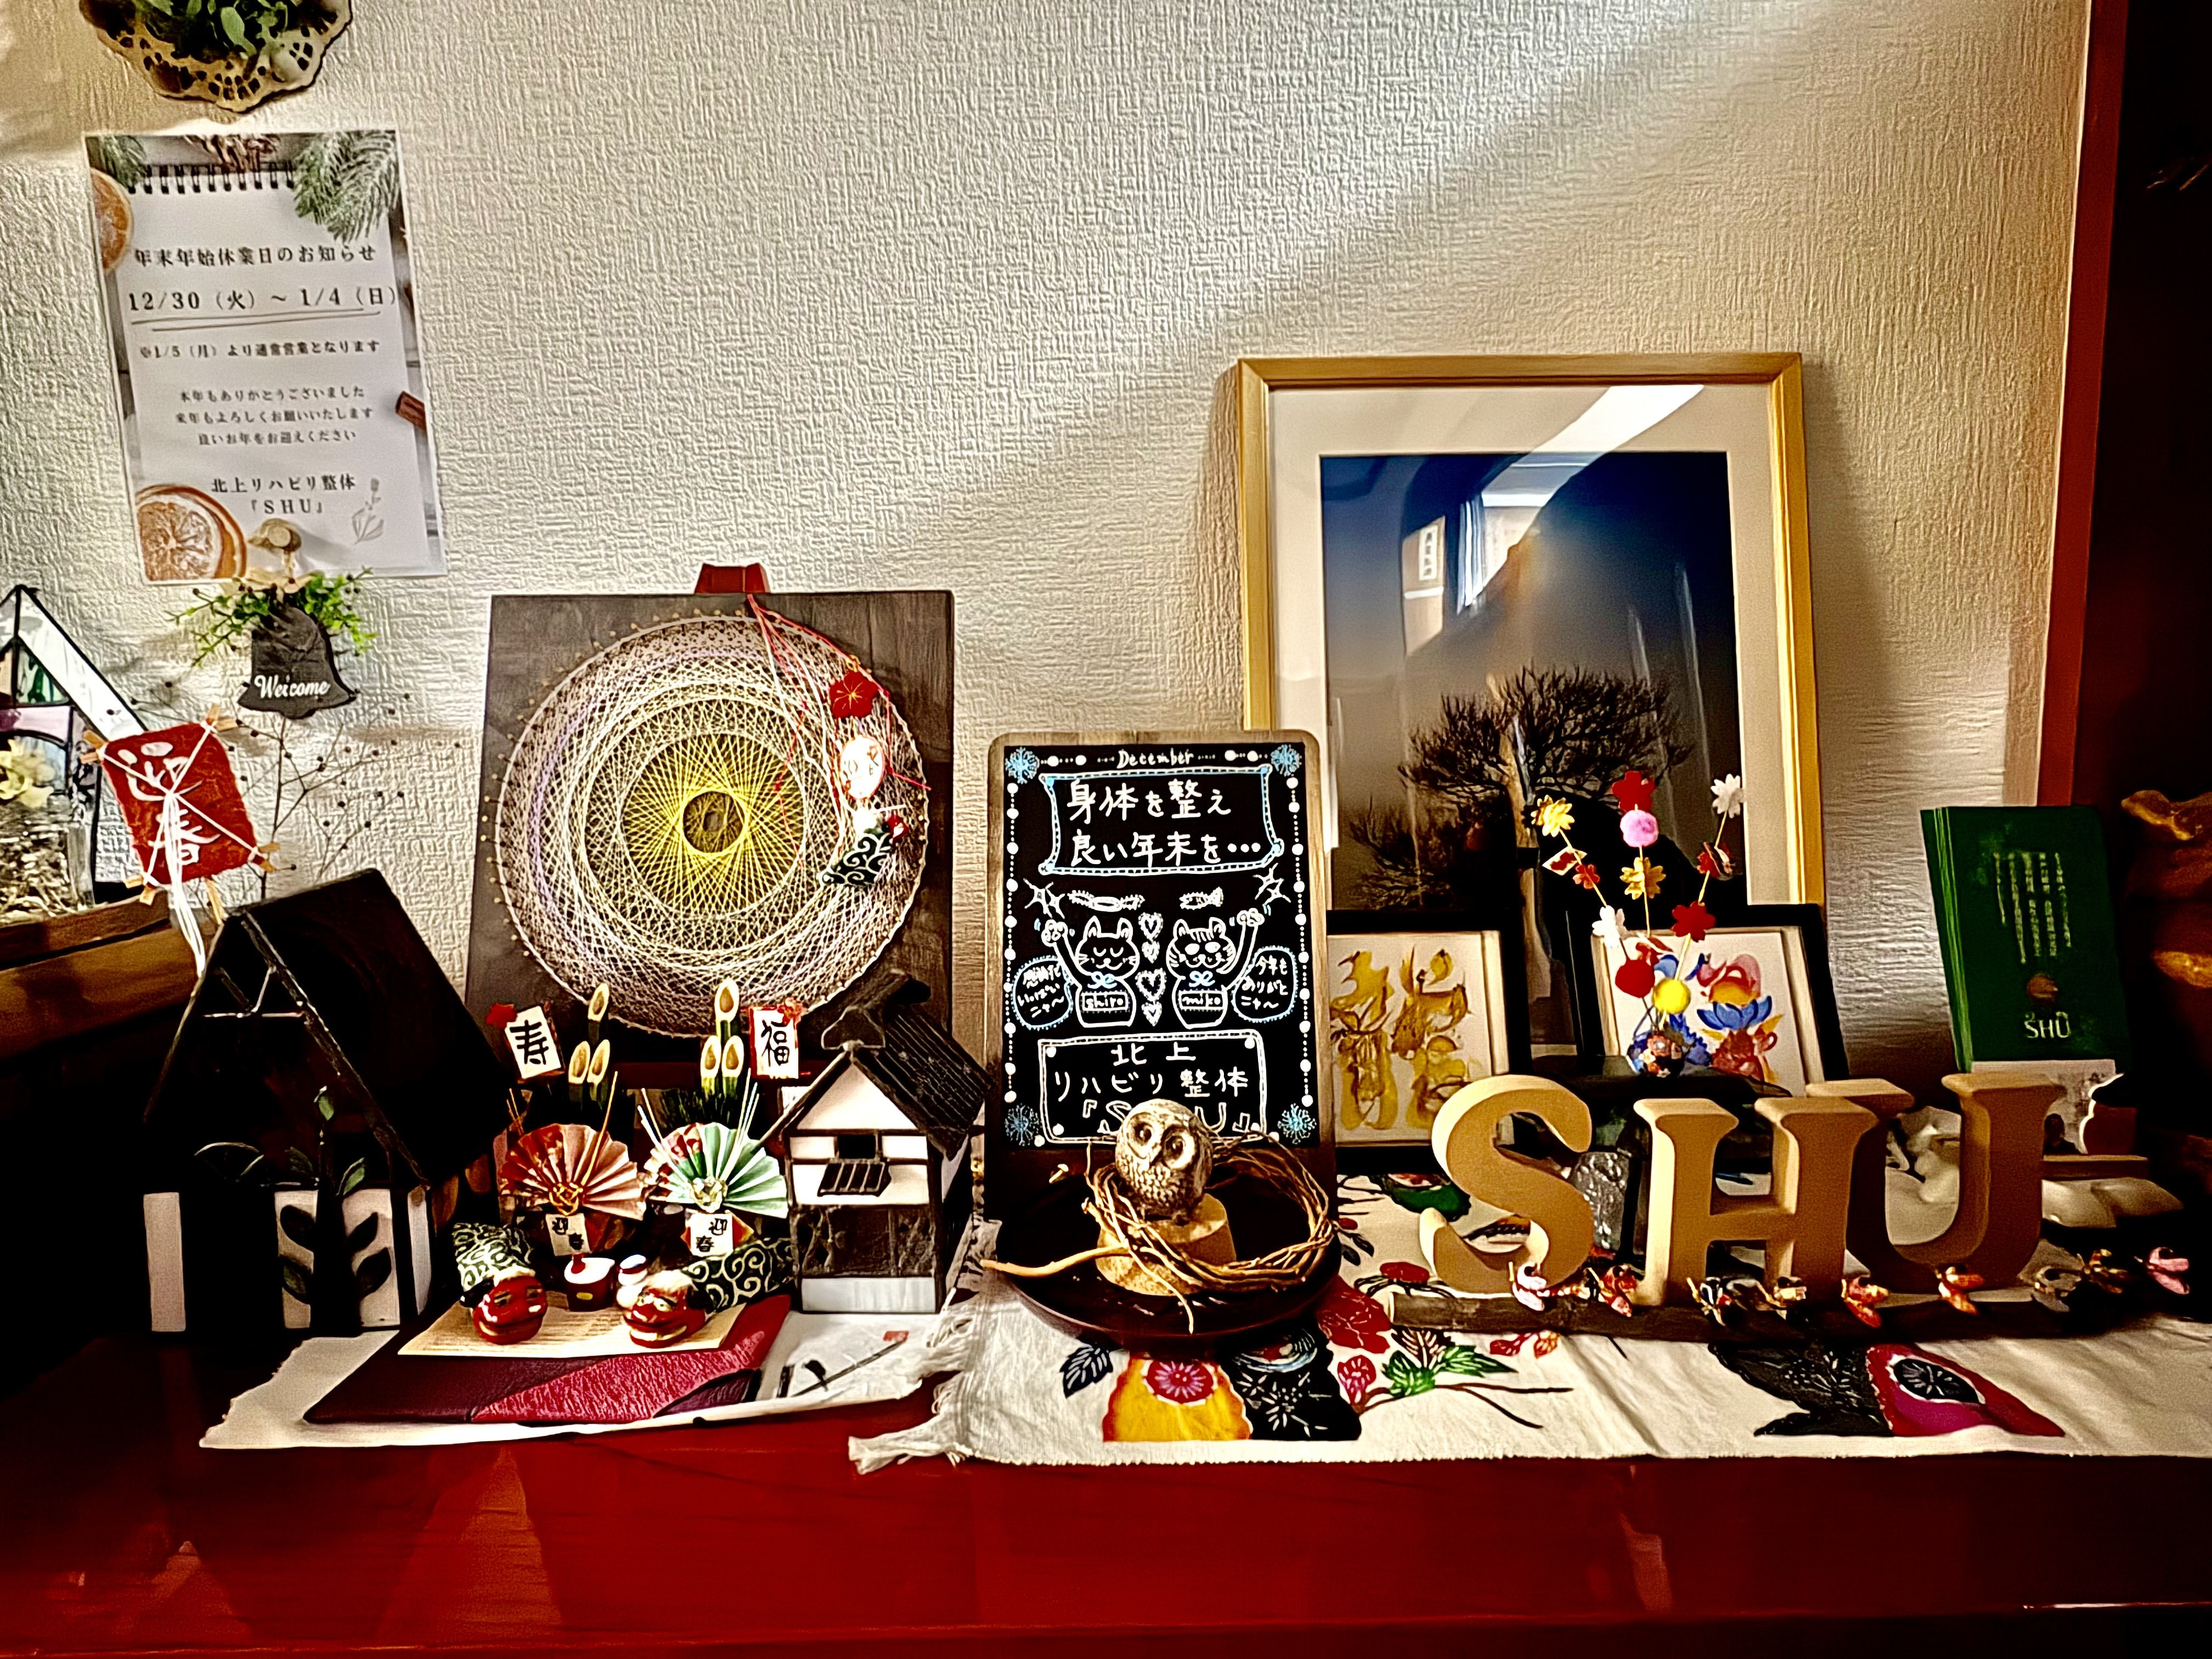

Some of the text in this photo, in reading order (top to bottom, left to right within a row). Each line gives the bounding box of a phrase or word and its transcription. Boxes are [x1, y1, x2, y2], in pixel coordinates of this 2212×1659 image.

[134, 245, 376, 268] 年末年始休業日のお知らせ
[211, 473, 356, 493] 北上リハビリ整体
[253, 674, 331, 699] Welcome
[1116, 747, 1194, 769] December
[1066, 778, 1232, 825] 身体を整え
[509, 1019, 550, 1065] 寿
[761, 1019, 790, 1066] 福
[1419, 1074, 2066, 1307] SHU
